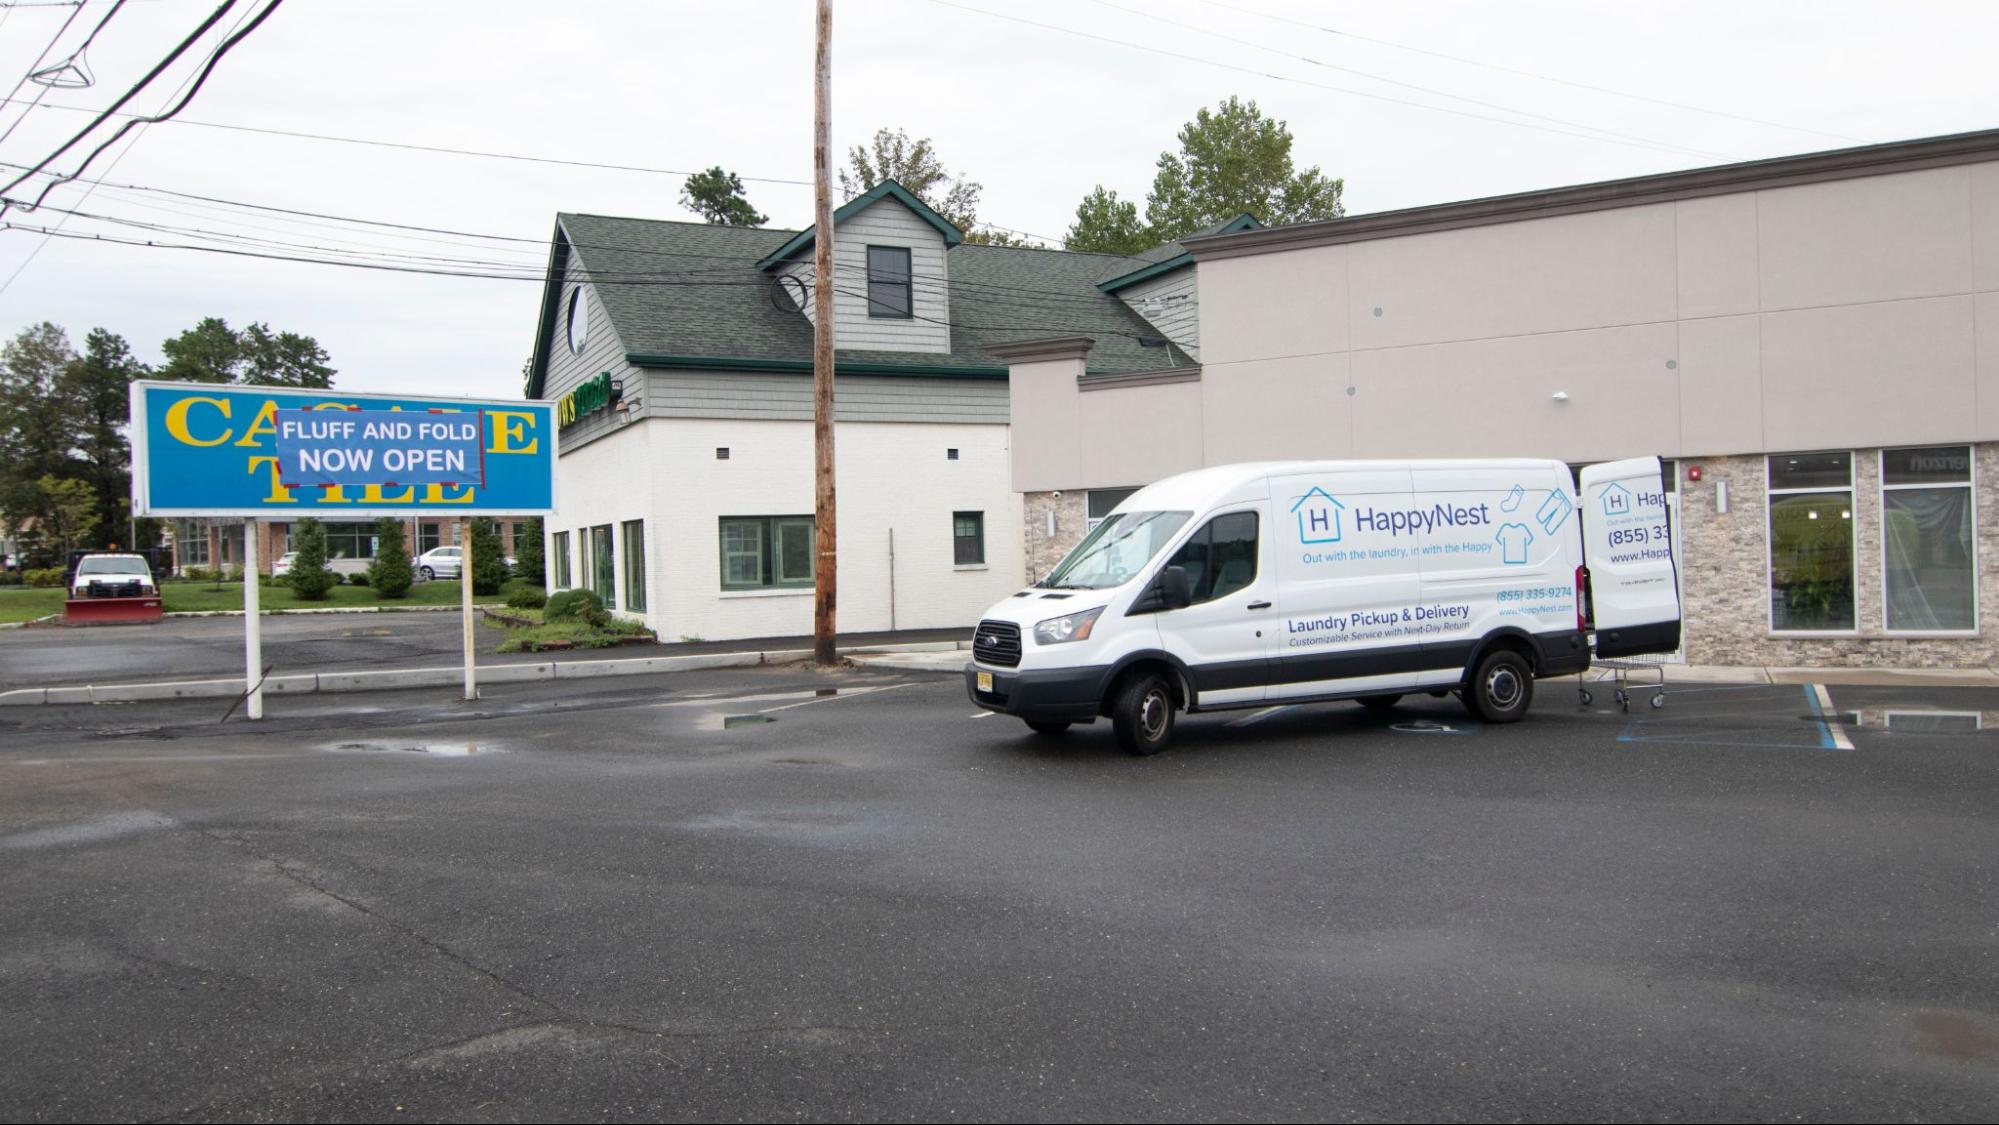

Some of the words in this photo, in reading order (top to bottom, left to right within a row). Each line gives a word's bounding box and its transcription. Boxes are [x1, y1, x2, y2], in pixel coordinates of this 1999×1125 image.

[165, 397, 538, 455] CAE
[282, 421, 356, 440] FLUFF
[363, 422, 412, 440] AND
[419, 422, 477, 441] FOLD
[300, 448, 373, 472] NOW
[383, 448, 465, 472] OPEN
[1610, 495, 1623, 508] H
[1310, 508, 1329, 532] H
[1355, 503, 1491, 536] HappyNest
[1609, 527, 1649, 548] (855)
[1302, 552, 1322, 564] Out
[1325, 550, 1347, 562] with
[1350, 548, 1366, 560] the
[1368, 546, 1409, 559] laundry,
[1411, 547, 1419, 556] in
[1422, 545, 1443, 555] with
[1444, 543, 1460, 554] the
[1462, 541, 1493, 554] Happy
[1496, 589, 1524, 604] (855)
[1526, 586, 1572, 600] 335-9274
[1288, 616, 1347, 633] Laundry
[1351, 609, 1399, 626] Pickup
[1402, 608, 1412, 622] &
[1415, 604, 1470, 620] Delivery
[1289, 633, 1349, 648] Customizable
[1351, 630, 1383, 641] Service
[1384, 628, 1402, 638] with
[1404, 624, 1442, 636] Next-Day
[1443, 620, 1470, 632] Return
